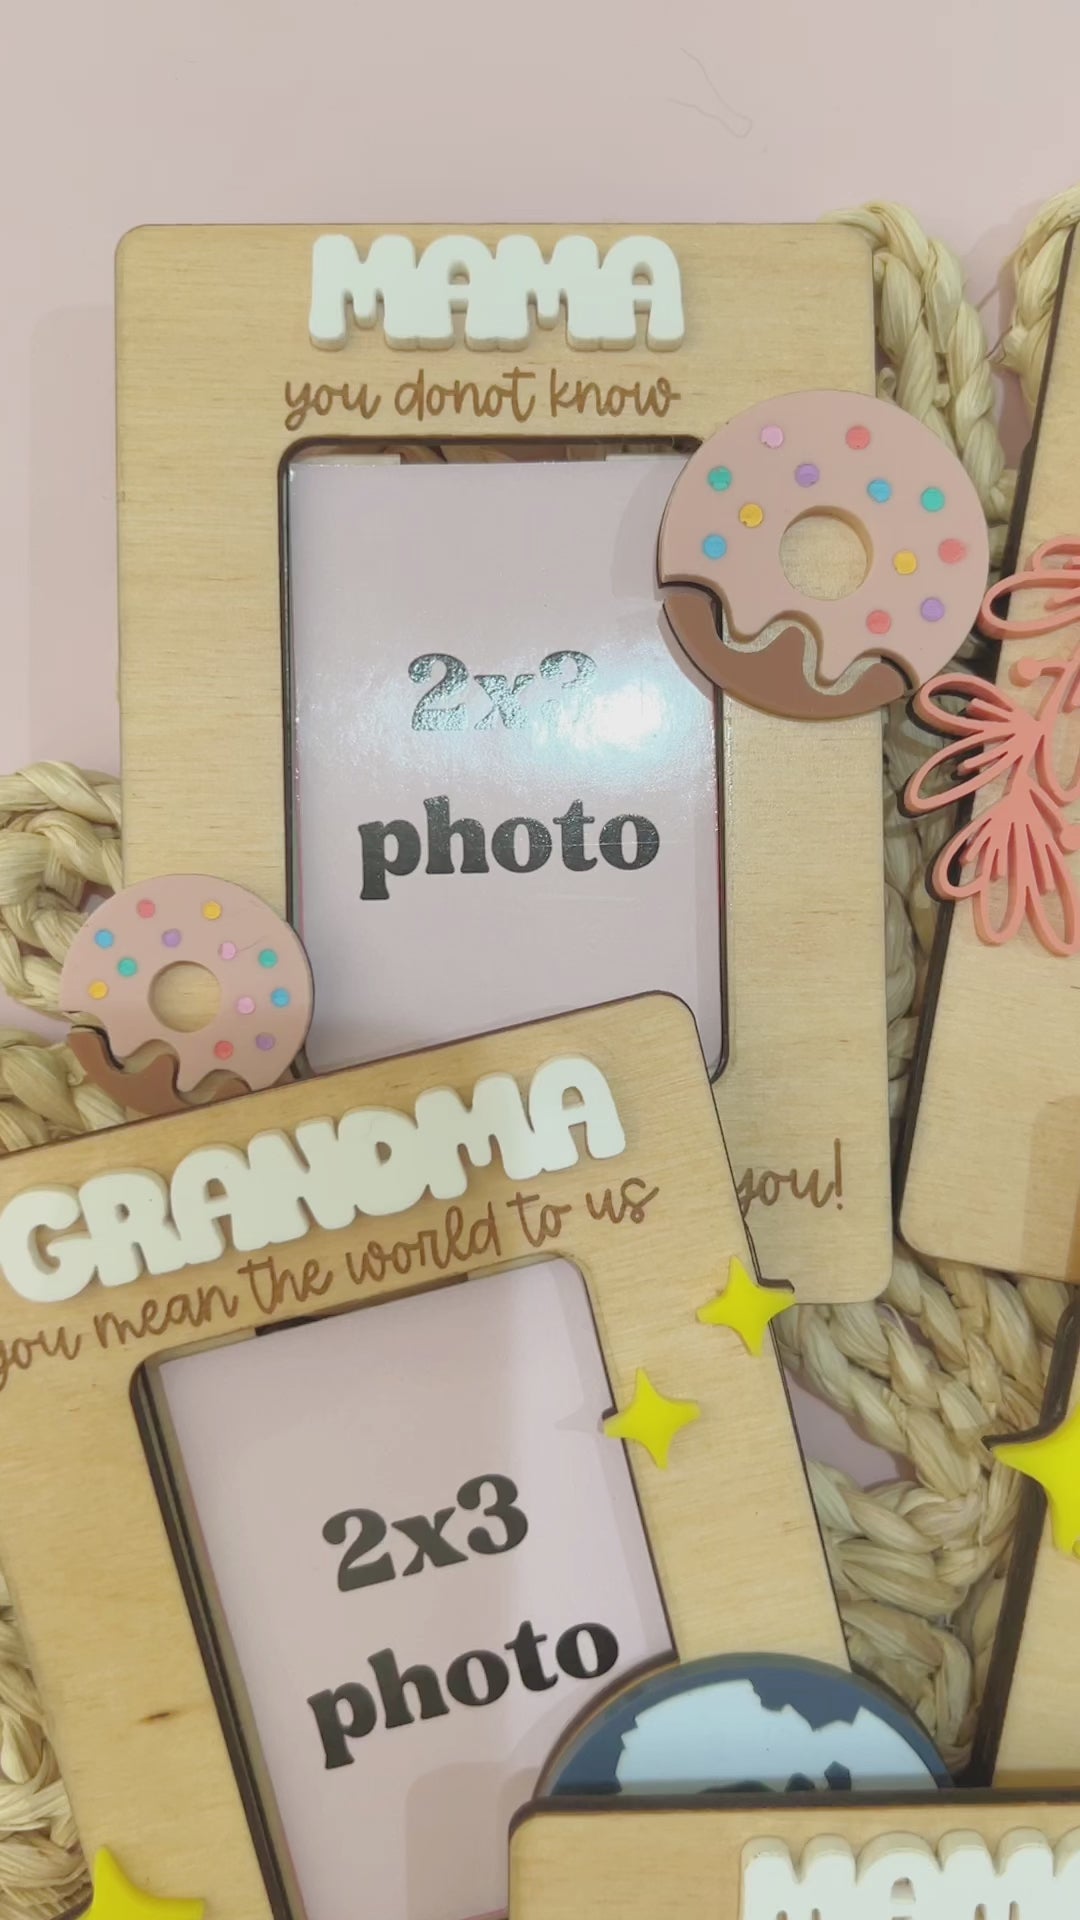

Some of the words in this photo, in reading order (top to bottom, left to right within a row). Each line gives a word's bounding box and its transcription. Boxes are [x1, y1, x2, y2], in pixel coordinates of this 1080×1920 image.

[308, 233, 686, 351] MAMA
[284, 378, 382, 432] you
[549, 368, 682, 418] know
[358, 795, 661, 901] photo
[0, 1054, 626, 1303] GRANDMA
[93, 1285, 239, 1350] mean
[237, 1256, 334, 1315] the
[345, 1201, 502, 1286] world
[506, 1191, 573, 1248] to
[585, 1177, 660, 1225] us
[322, 1473, 528, 1592] 2x3
[307, 1620, 619, 1770] photo
[740, 1828, 1080, 1920] MAM
